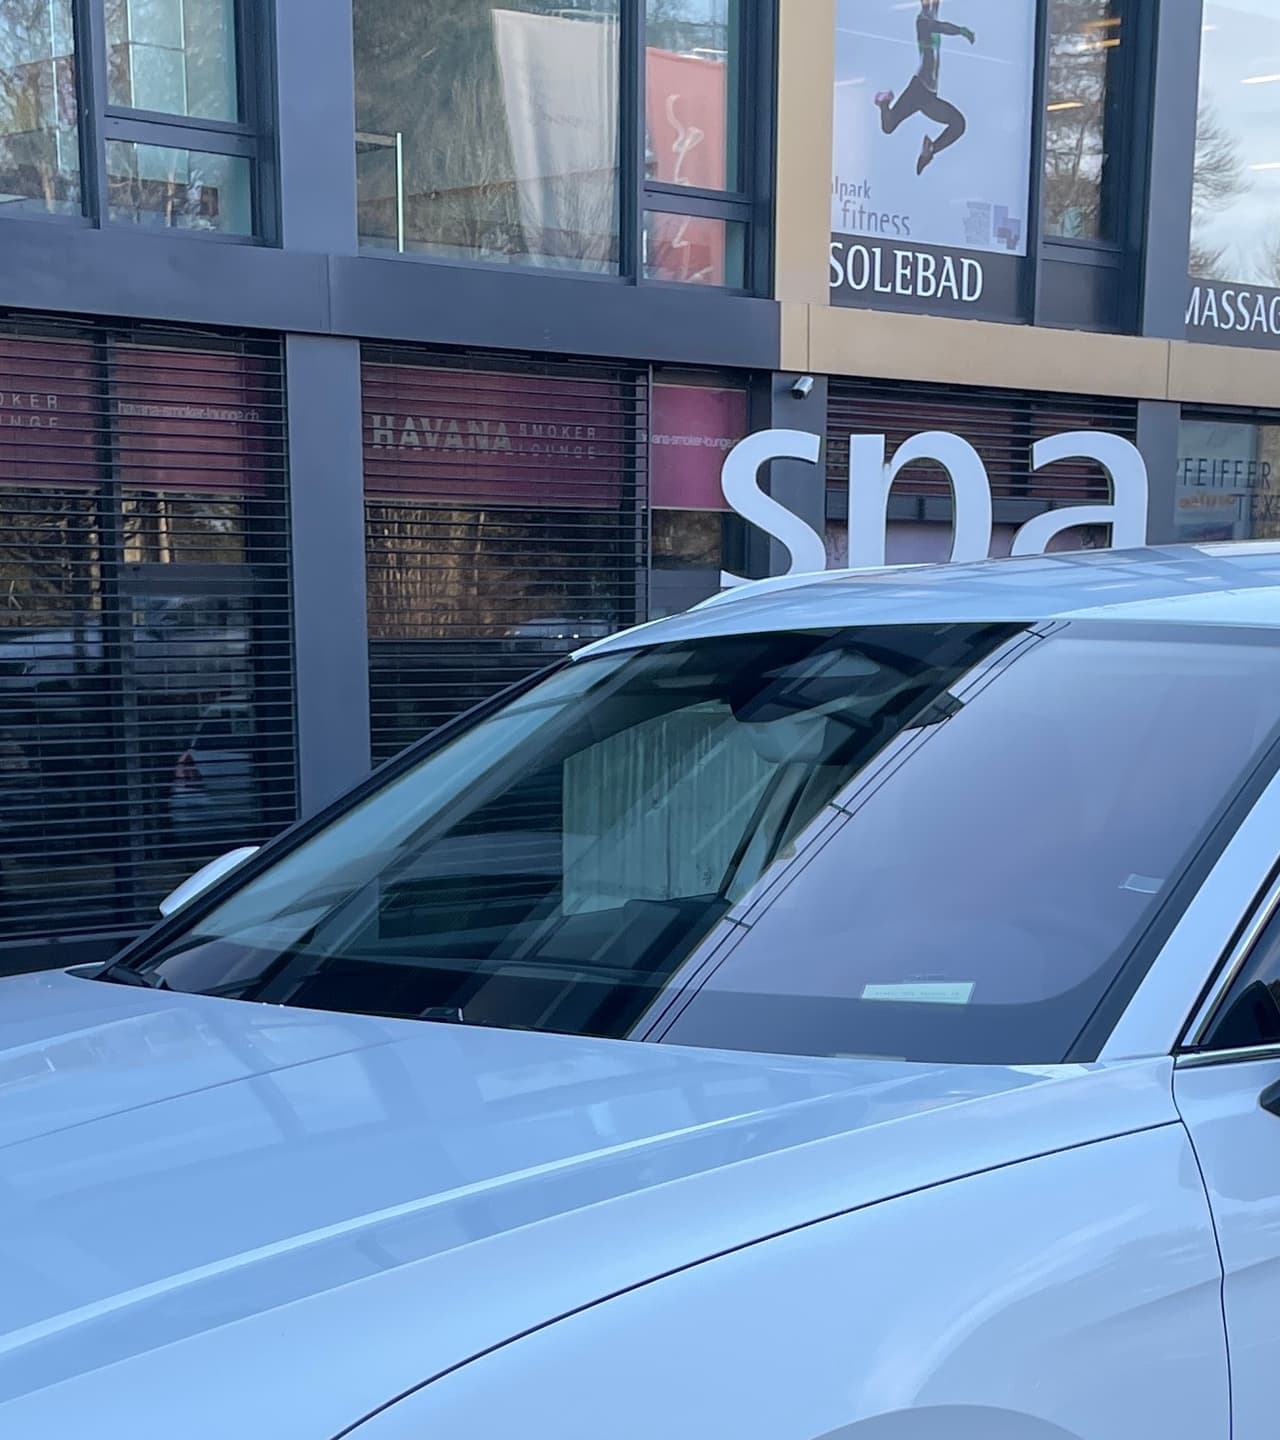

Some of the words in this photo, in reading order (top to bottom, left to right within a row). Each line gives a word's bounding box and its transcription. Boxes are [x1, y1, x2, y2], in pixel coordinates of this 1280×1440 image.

[831, 176, 871, 201] lpark
[841, 200, 911, 236] fitness
[830, 241, 983, 302] SOLEBAD
[372, 415, 513, 455] HAVANA
[520, 423, 596, 441] SMOKER
[1176, 457, 1272, 489] FEIFFER
